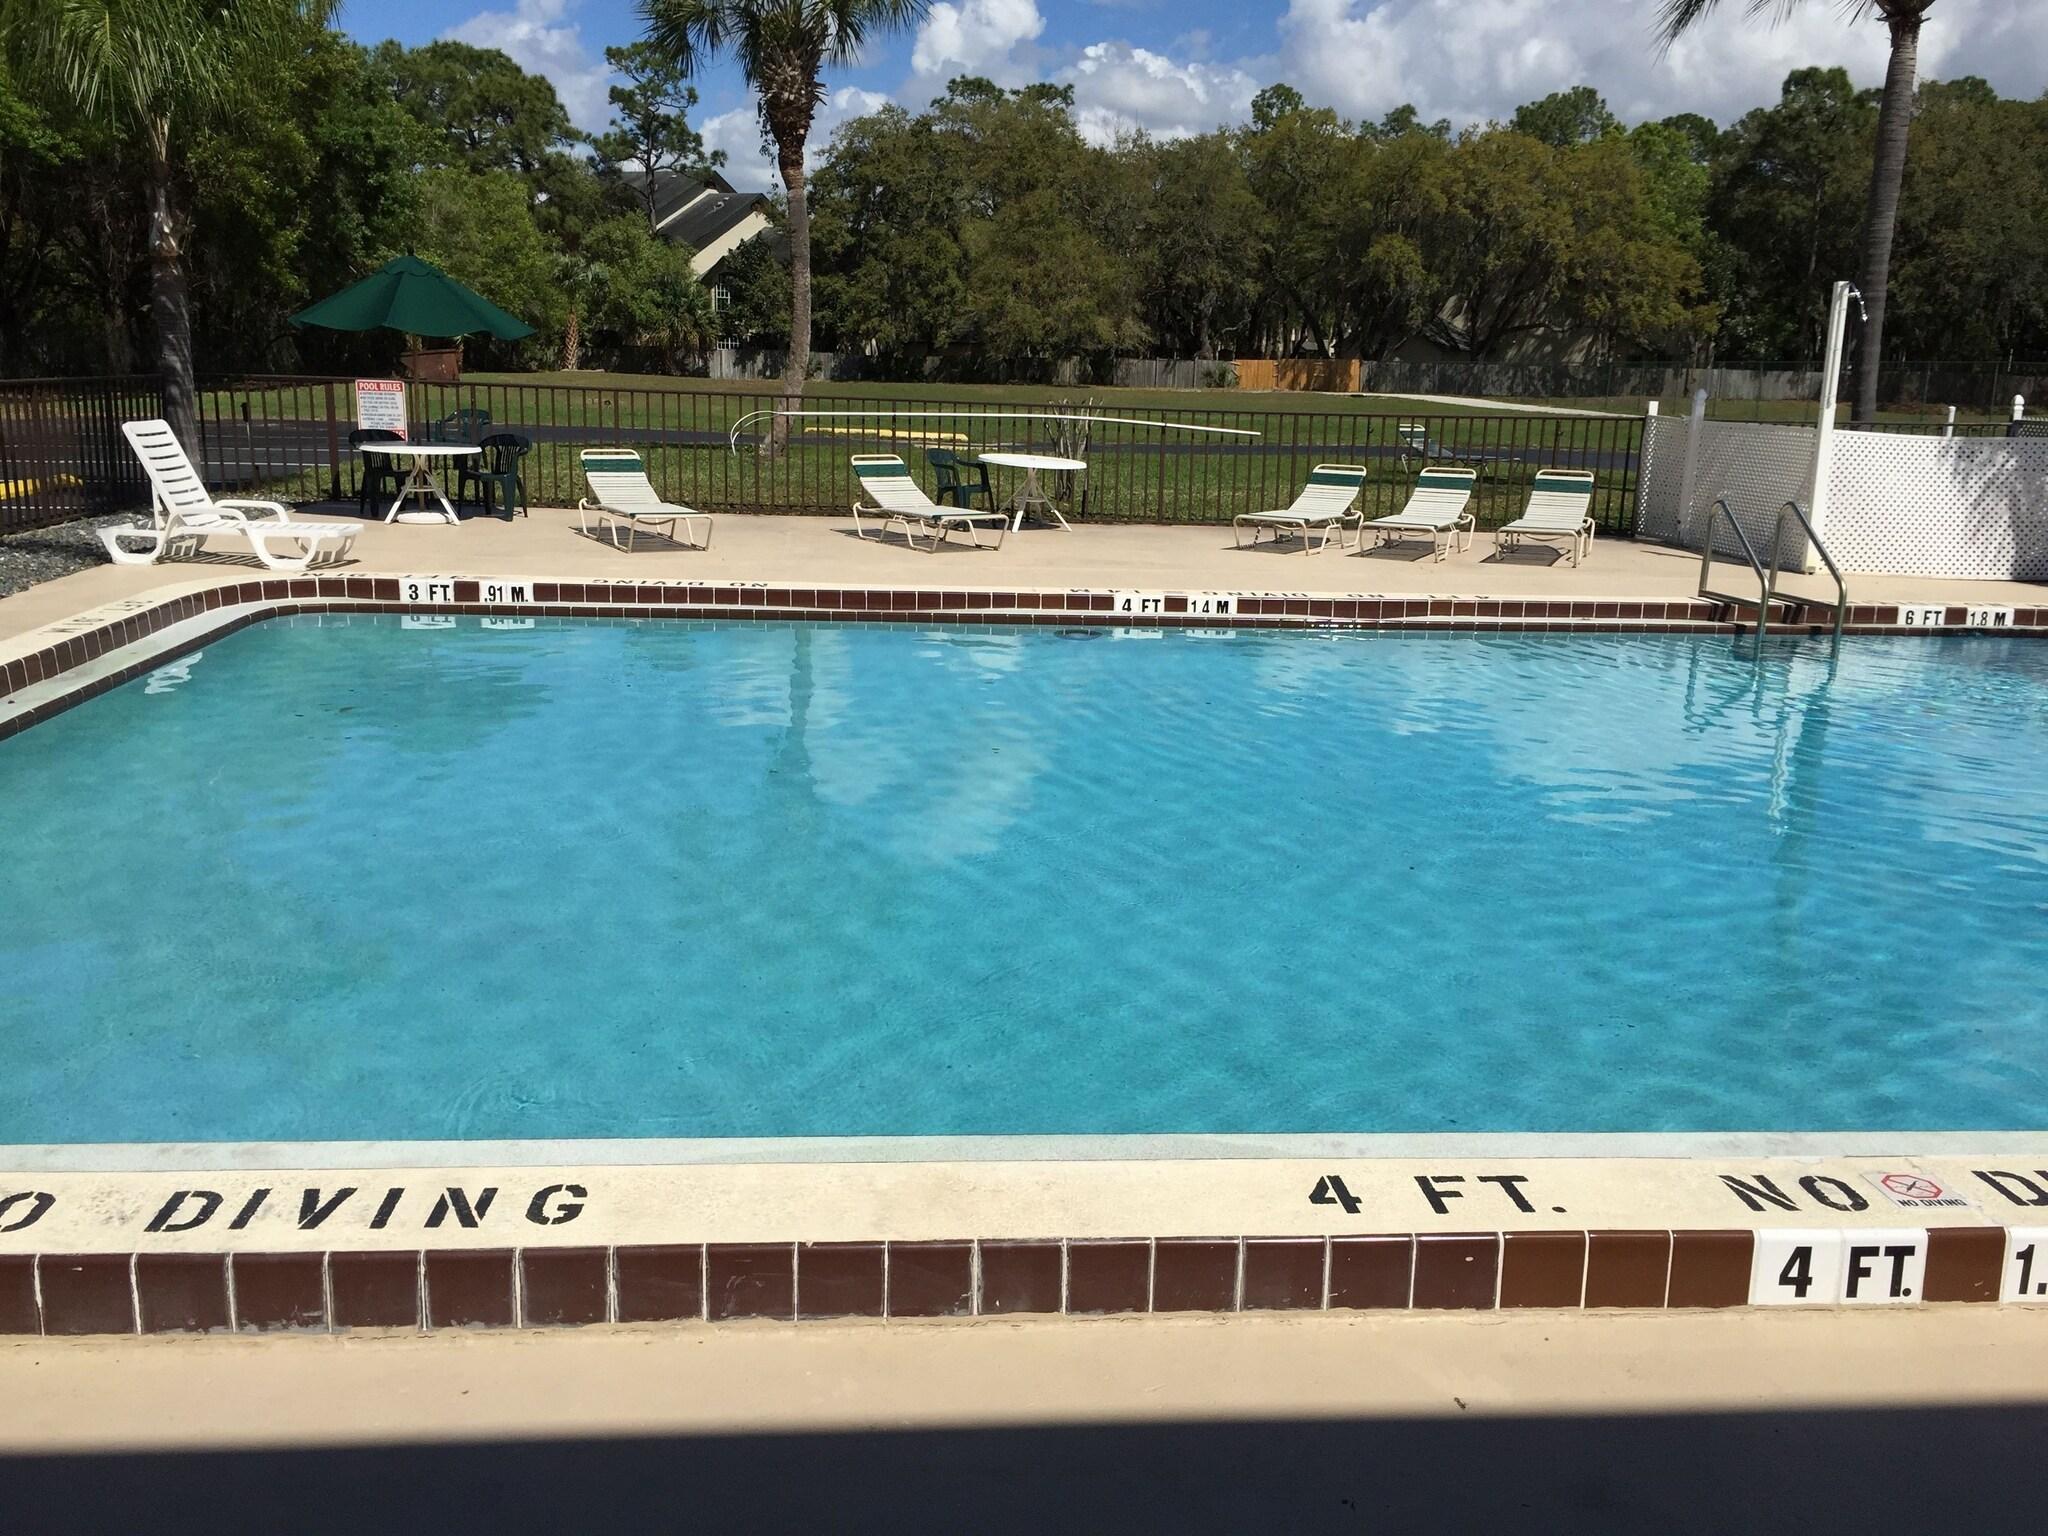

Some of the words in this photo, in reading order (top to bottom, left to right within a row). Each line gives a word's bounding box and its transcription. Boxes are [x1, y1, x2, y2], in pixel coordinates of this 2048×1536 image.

[359, 382, 379, 390] POOL
[379, 383, 401, 391] RULES
[408, 583, 419, 601] 3
[429, 584, 451, 602] FT.
[1122, 598, 1132, 612] 4
[1142, 599, 1161, 613] FT
[1905, 610, 1915, 625] 6
[1970, 611, 1989, 626] 1.8
[1308, 1174, 1362, 1214] 4
[1413, 1173, 1567, 1215] FT.
[1721, 1173, 1871, 1213] NO
[143, 1183, 590, 1233] DIVING
[1897, 1199, 1919, 1207] NO
[1919, 1199, 1968, 1207] DIVING
[1778, 1246, 1813, 1298] 4
[1846, 1245, 1916, 1298] FT.
